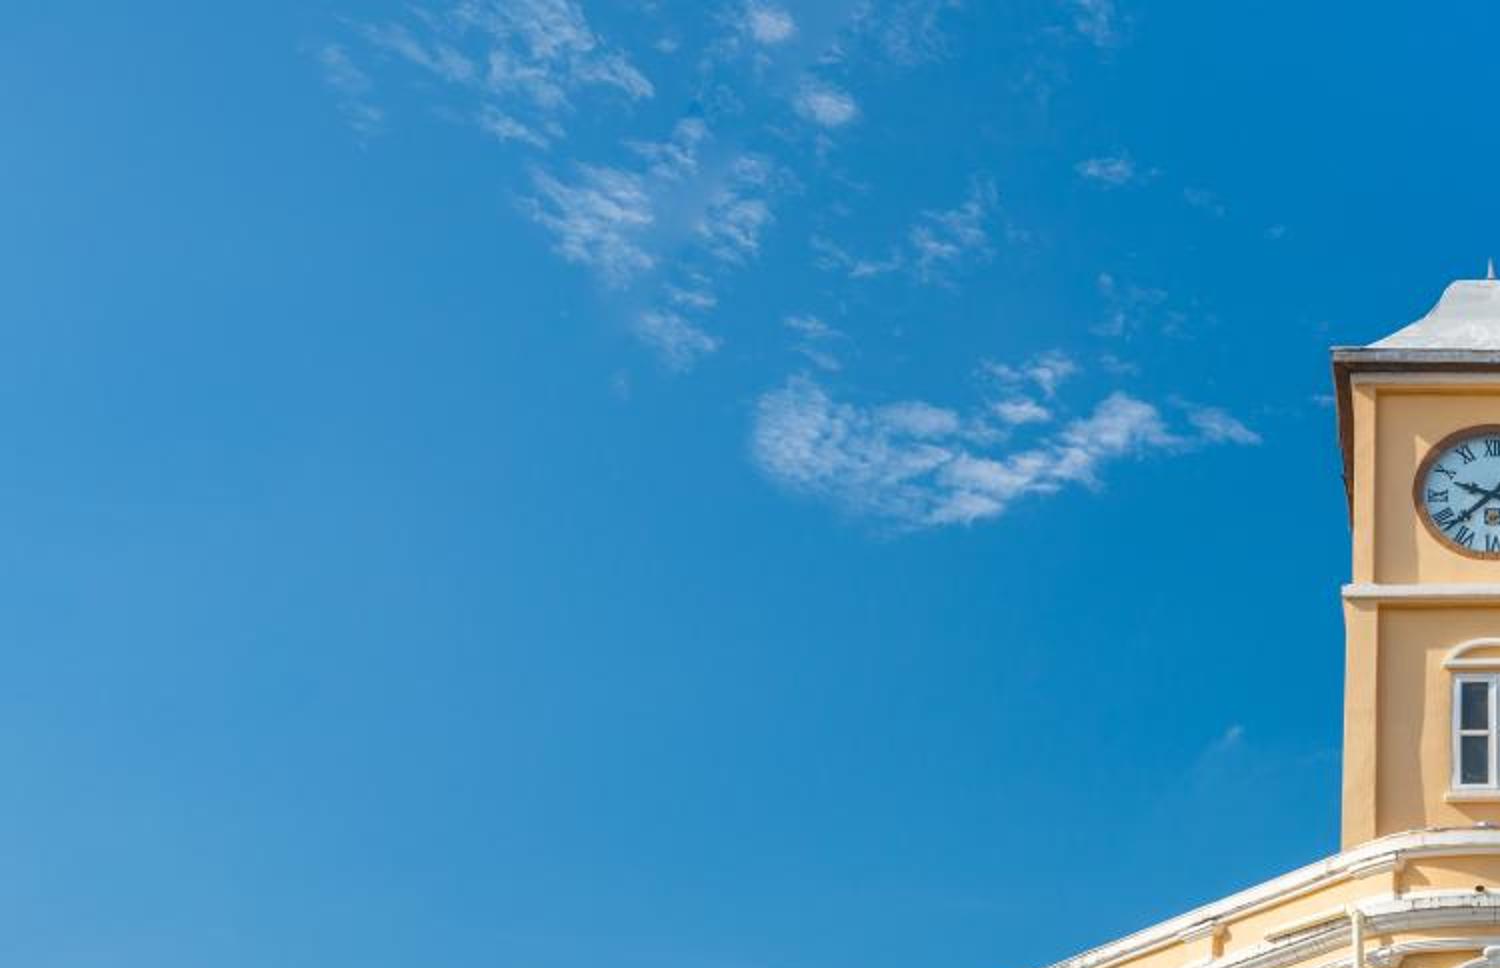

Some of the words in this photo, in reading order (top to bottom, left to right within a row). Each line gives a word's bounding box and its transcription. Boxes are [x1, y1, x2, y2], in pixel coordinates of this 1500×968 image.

[1456, 444, 1476, 464] XI
[1434, 464, 1457, 480] X
[1428, 489, 1449, 503] IX
[1455, 525, 1475, 548] VII
[1485, 533, 1500, 552] VI
